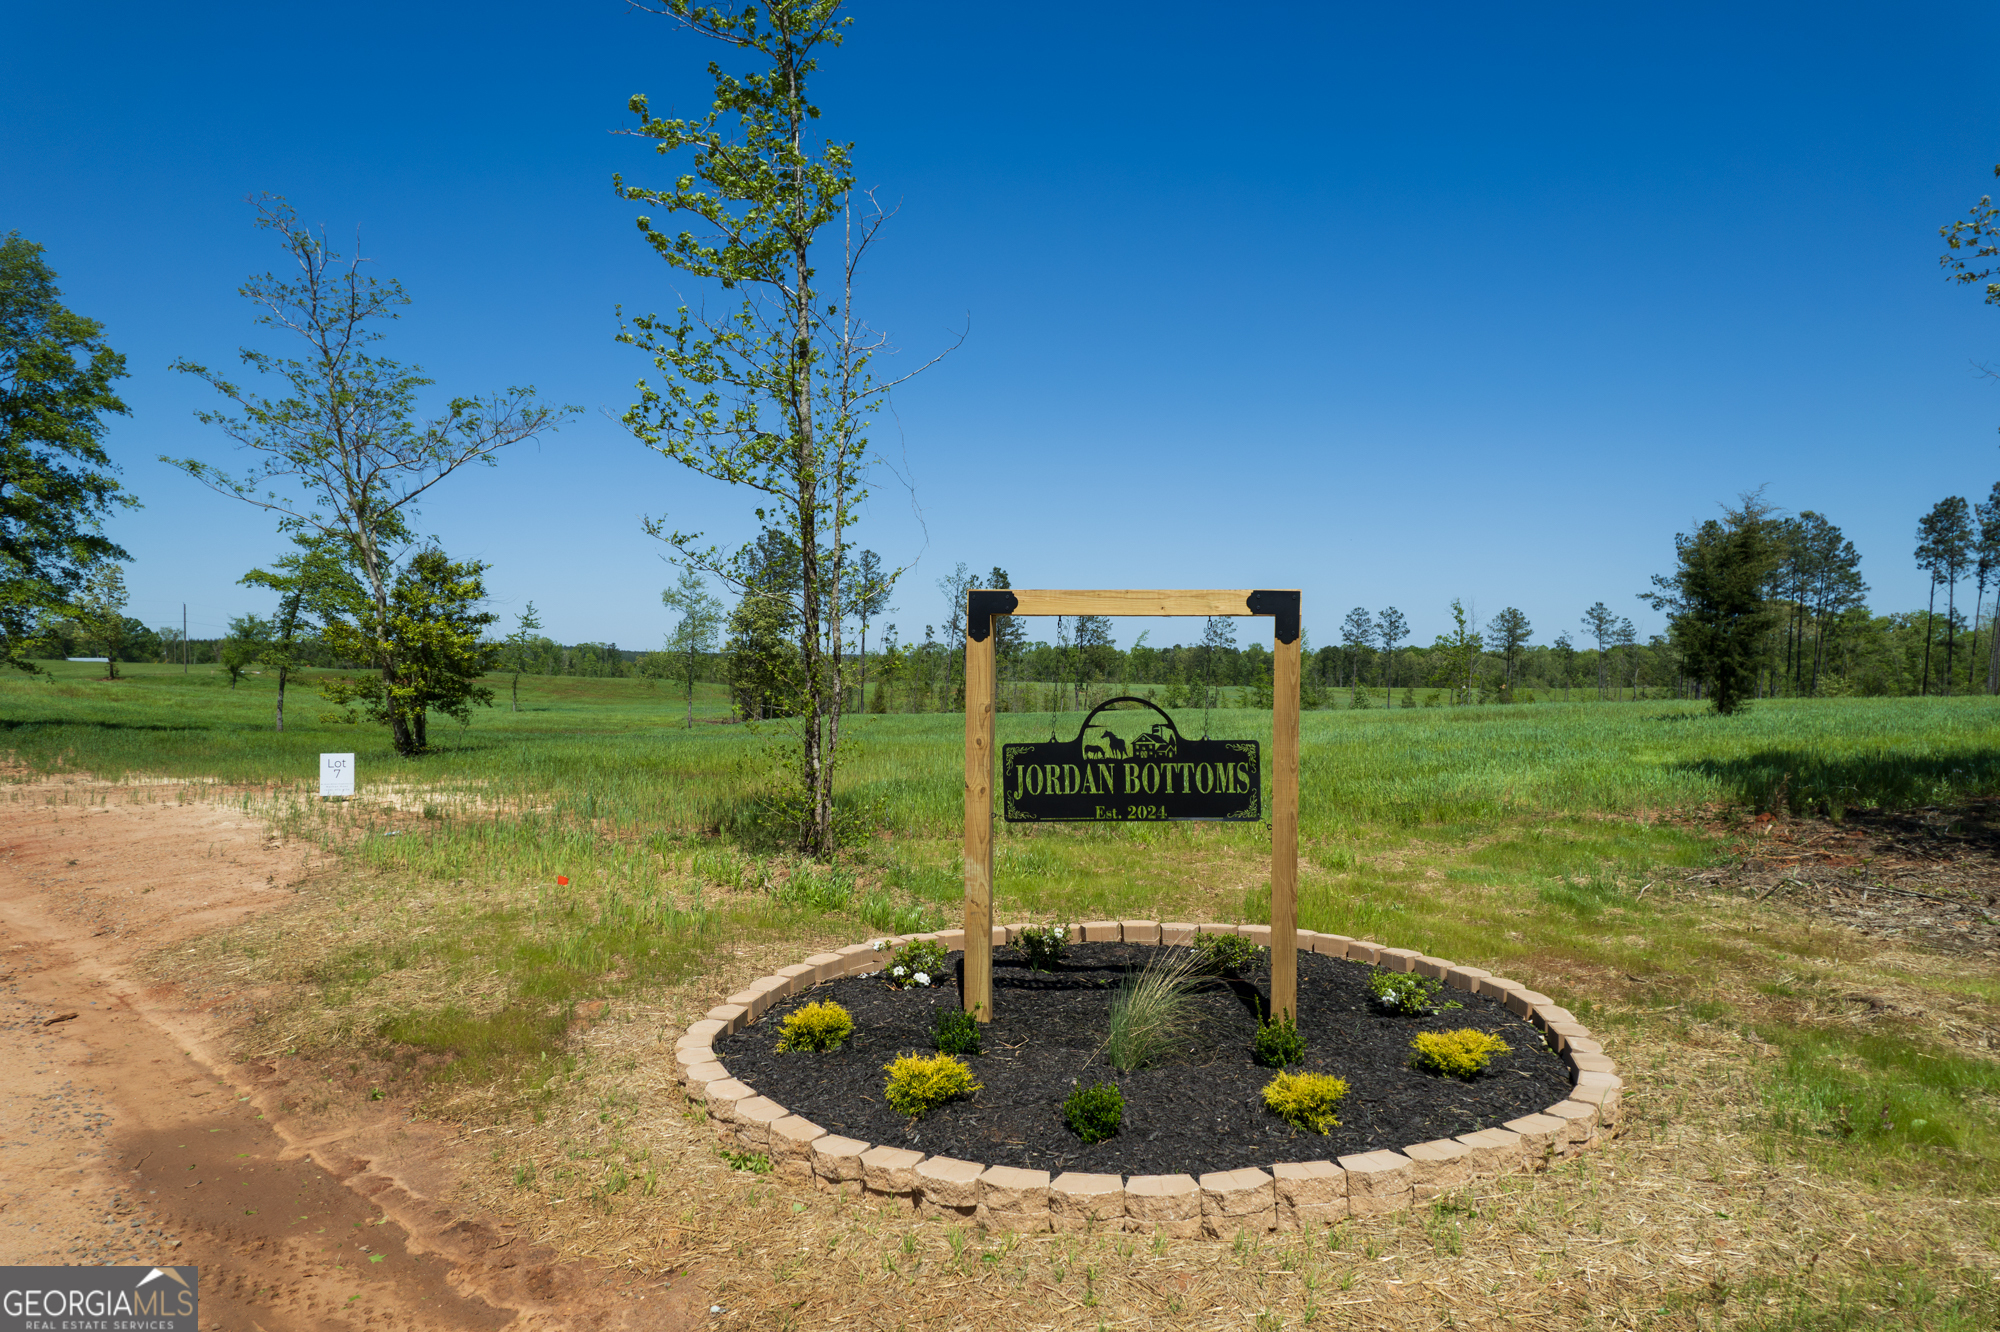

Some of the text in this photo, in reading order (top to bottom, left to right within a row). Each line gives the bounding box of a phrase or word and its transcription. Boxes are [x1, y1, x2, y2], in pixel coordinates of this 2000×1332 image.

[327, 759, 346, 768] Lot
[333, 769, 341, 778] 7
[1013, 762, 1250, 800] JORDAN BOTTOMS
[1095, 805, 1168, 820] Est. 2024
